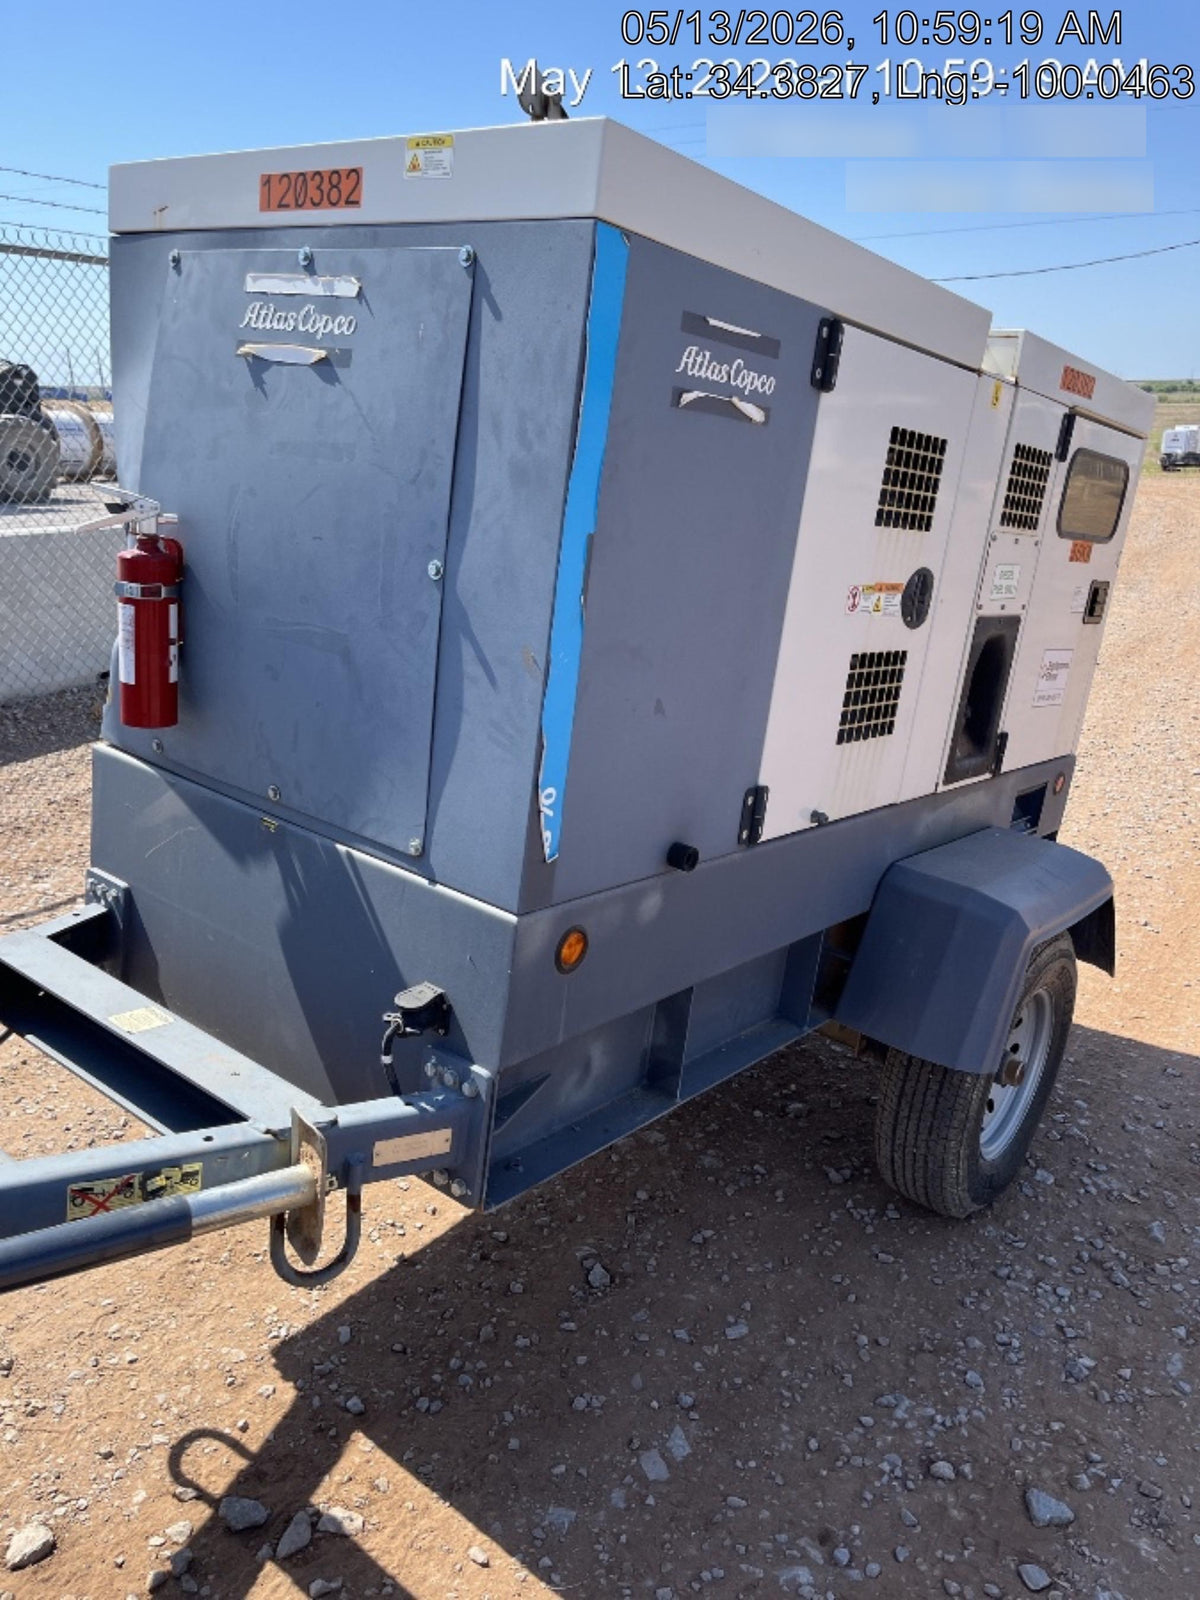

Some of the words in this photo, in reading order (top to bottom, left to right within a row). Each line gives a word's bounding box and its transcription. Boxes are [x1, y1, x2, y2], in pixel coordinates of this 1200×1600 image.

[261, 168, 361, 209] 120382
[240, 301, 296, 331] Atlas
[297, 304, 358, 340] Copco
[675, 345, 730, 384] Atlas
[730, 358, 776, 396] Copco
